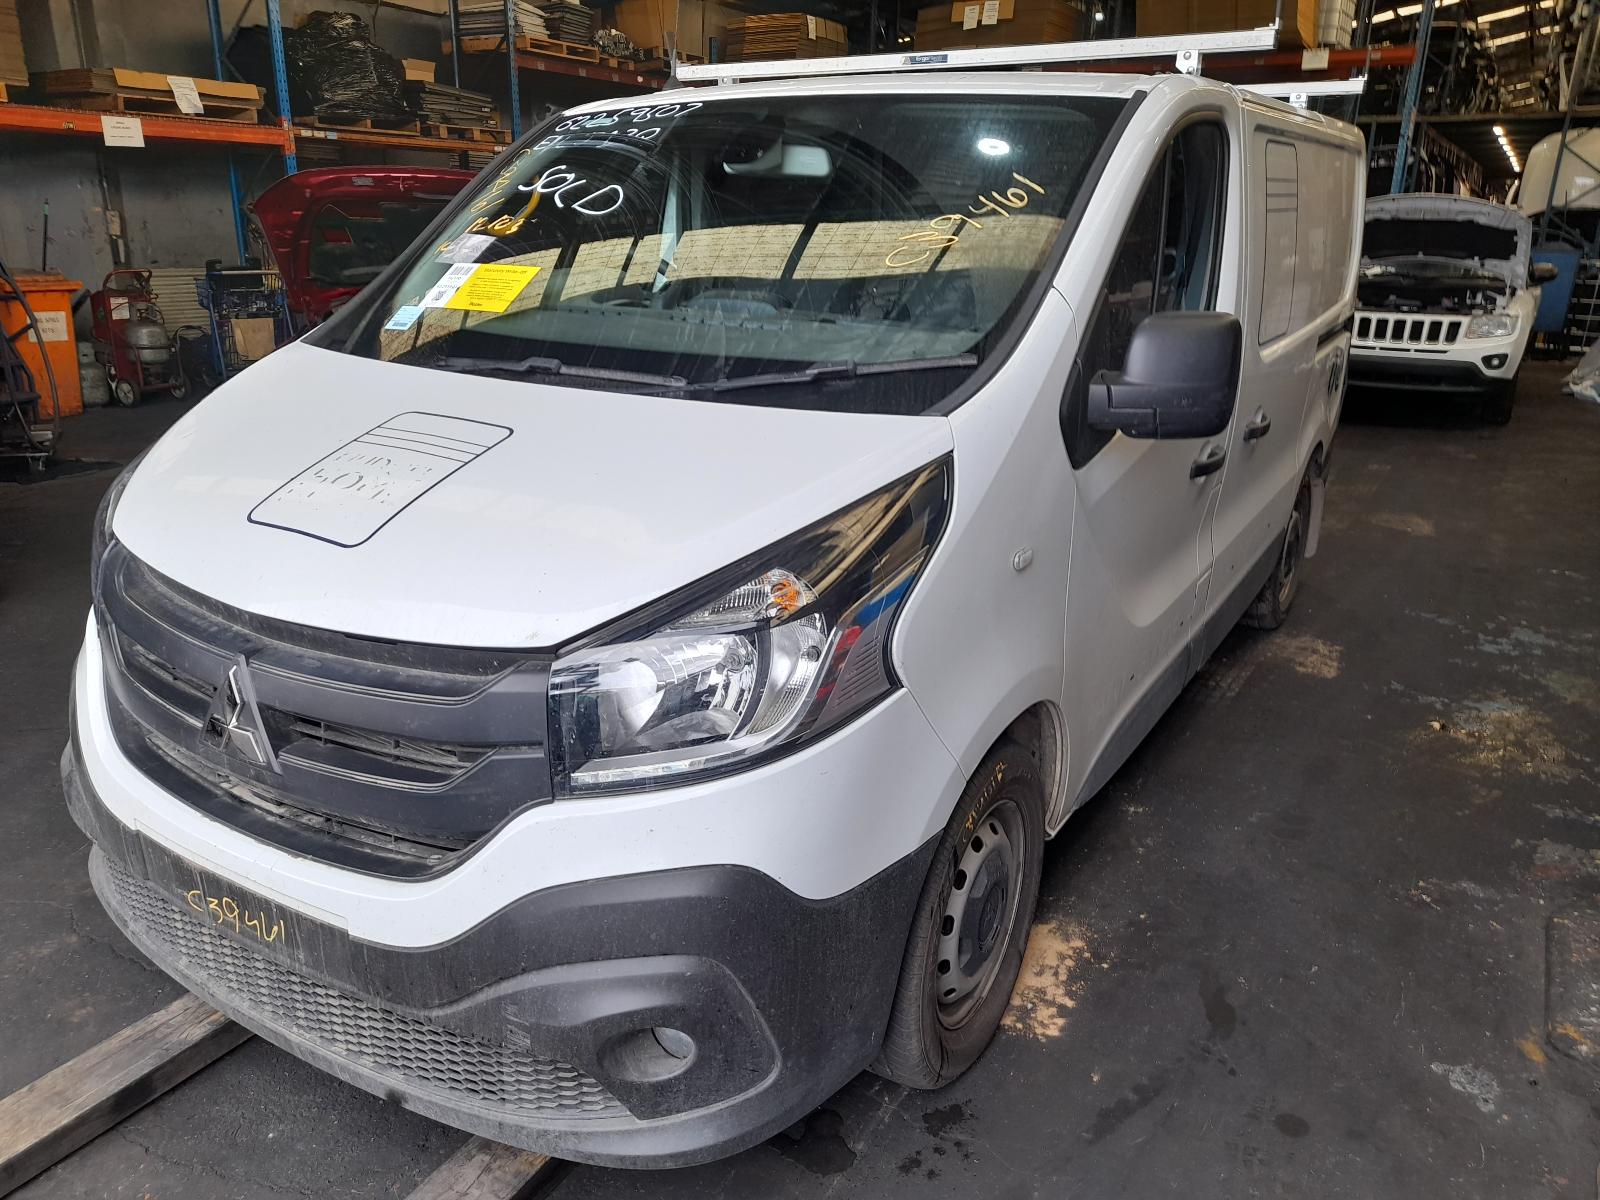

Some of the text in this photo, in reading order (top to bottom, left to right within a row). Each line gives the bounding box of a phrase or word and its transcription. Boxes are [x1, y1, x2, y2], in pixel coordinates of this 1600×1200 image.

[517, 164, 624, 215] SOLD
[885, 171, 1046, 268] C39461
[187, 889, 286, 945] C39461
